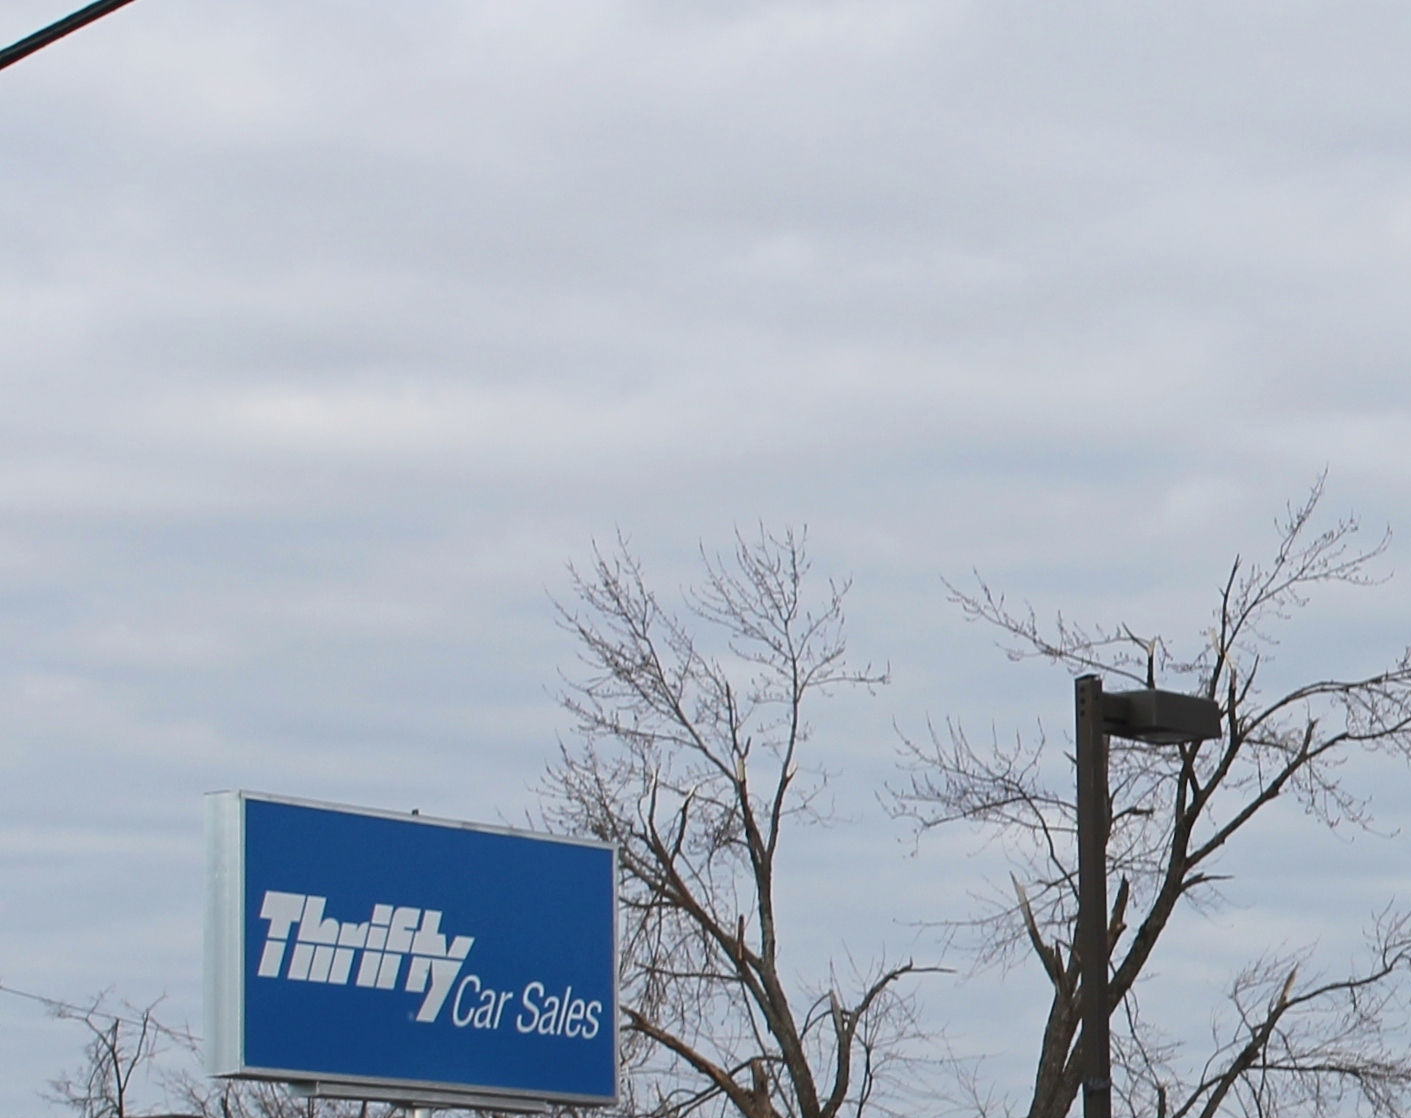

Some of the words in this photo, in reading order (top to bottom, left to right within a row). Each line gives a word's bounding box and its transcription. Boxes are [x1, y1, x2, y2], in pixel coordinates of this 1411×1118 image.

[257, 891, 475, 1023] Thrifty
[452, 975, 513, 1031] Car
[516, 981, 602, 1040] Sales
